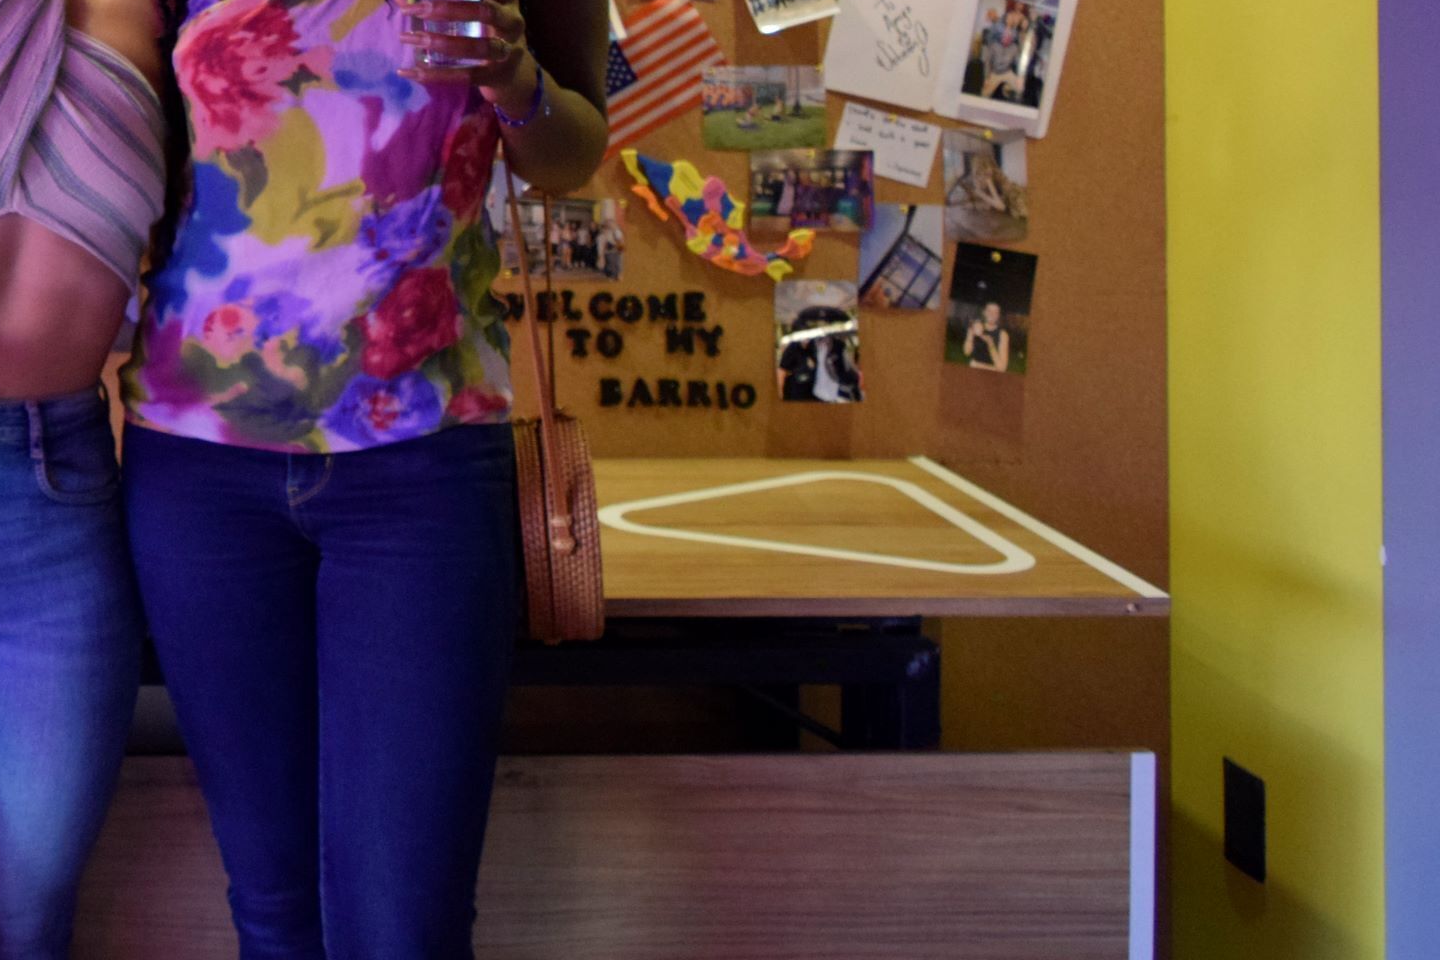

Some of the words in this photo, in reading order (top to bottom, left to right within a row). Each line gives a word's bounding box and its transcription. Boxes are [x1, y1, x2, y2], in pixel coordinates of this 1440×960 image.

[505, 291, 706, 322] WELCOME
[567, 329, 623, 358] TO
[667, 326, 722, 356] MY
[600, 378, 756, 408] BARRIO
